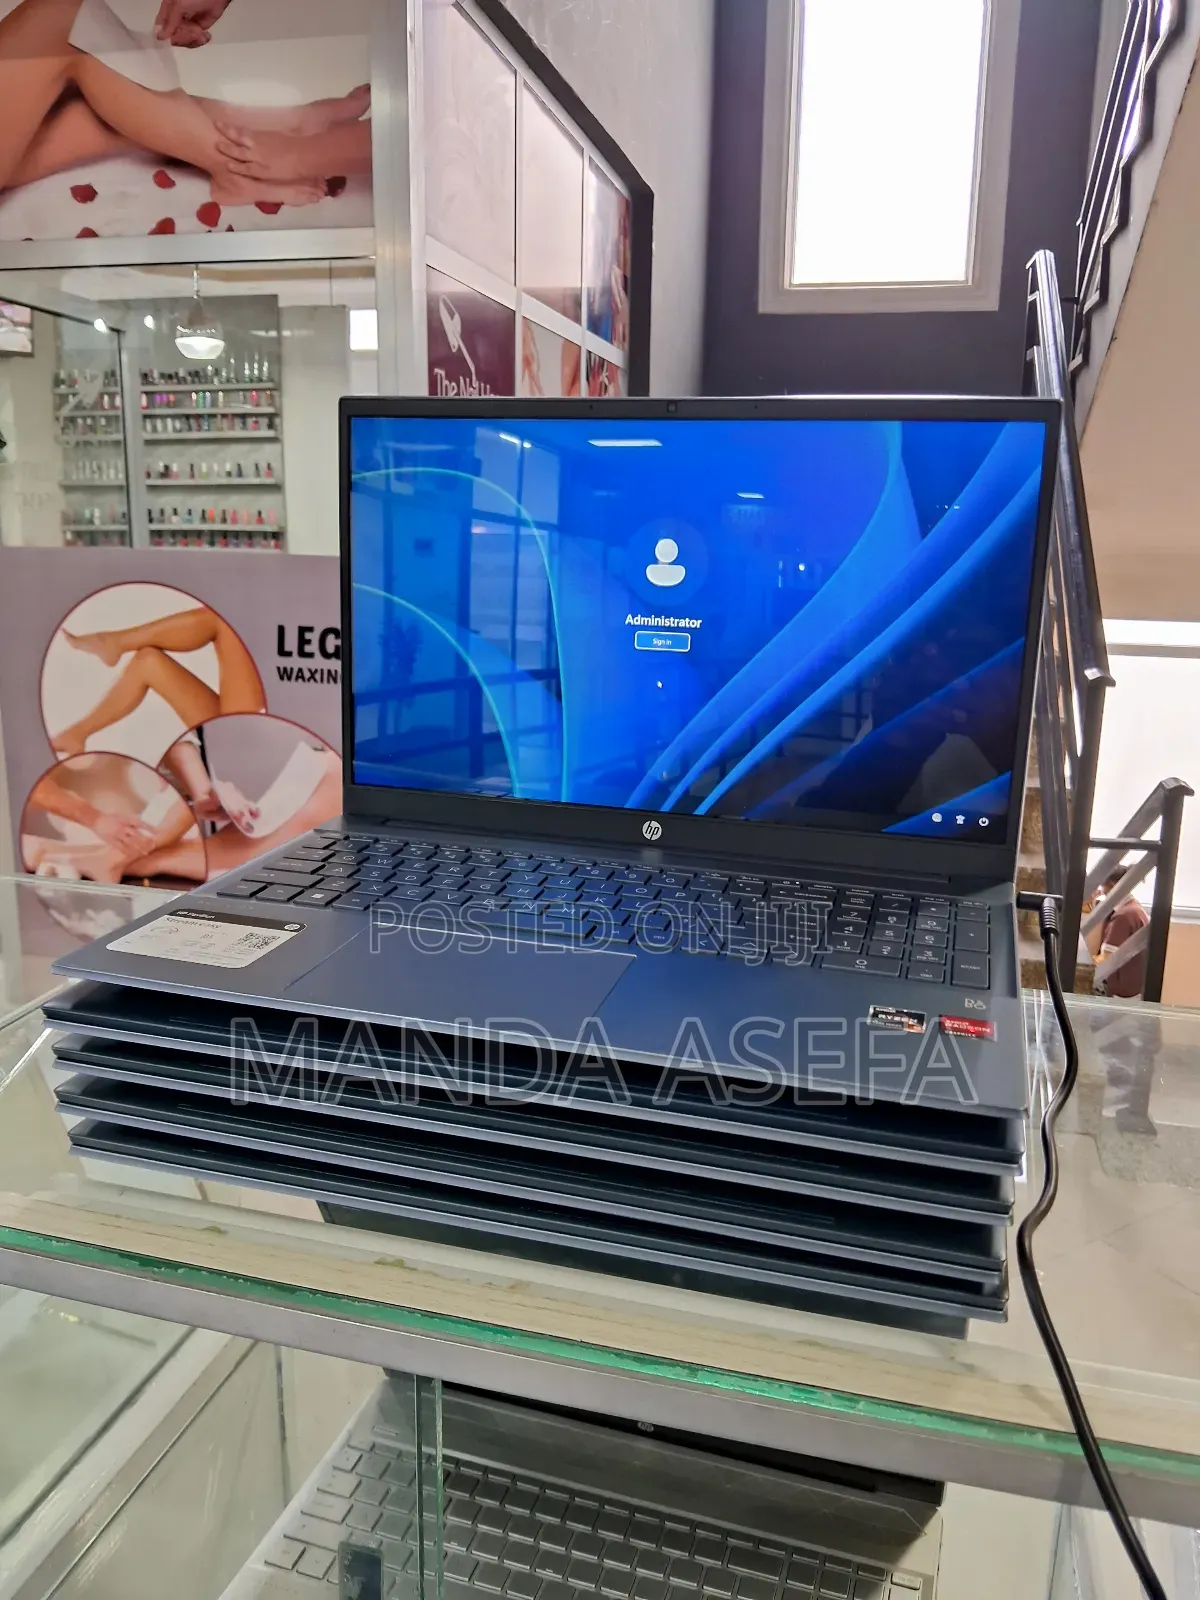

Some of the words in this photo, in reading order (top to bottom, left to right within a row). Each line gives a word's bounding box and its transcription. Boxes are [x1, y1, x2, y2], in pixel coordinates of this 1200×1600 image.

[434, 368, 458, 396] The
[625, 614, 702, 628] Administrator
[277, 624, 341, 660] LEG
[652, 637, 665, 645] Sign
[276, 666, 340, 685] WAXIN
[642, 820, 662, 840] hp
